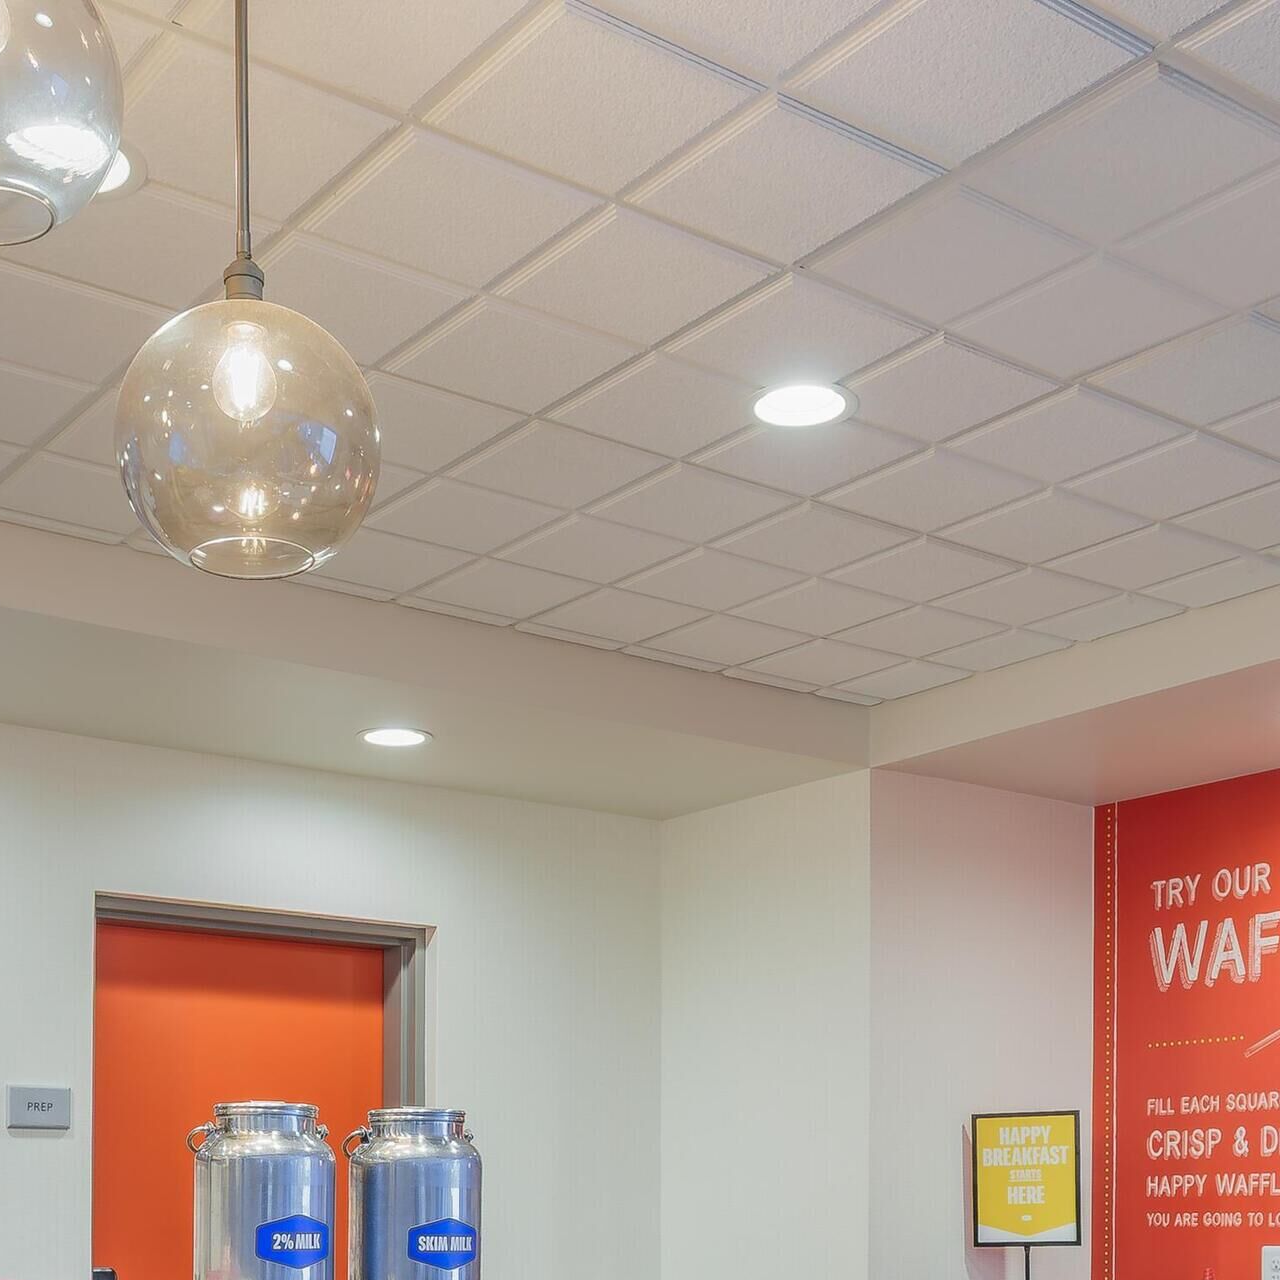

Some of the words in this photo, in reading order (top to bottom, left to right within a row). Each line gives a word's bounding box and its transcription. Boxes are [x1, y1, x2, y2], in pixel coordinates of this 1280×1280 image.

[1151, 873, 1201, 910] TRY
[1212, 862, 1271, 901] OUR
[27, 1101, 54, 1113] PREP
[1147, 1097, 1175, 1116] FILL
[1180, 1094, 1220, 1115] EACH
[999, 1125, 1052, 1145] HAPPY
[1146, 1127, 1222, 1160] CRISP
[1232, 1126, 1250, 1158] &
[982, 1145, 1069, 1167] BREAKFAST
[1008, 1169, 1042, 1180] STARTS
[1007, 1186, 1046, 1205] HERE
[1146, 1174, 1208, 1198] HAPPY
[1146, 1212, 1171, 1228] YOU
[1174, 1211, 1199, 1228] ARE
[1202, 1211, 1242, 1228] GOING
[1247, 1211, 1264, 1228] TO
[272, 1233, 293, 1250] 2%
[295, 1233, 321, 1250] MILK
[417, 1235, 448, 1252] SKIM
[450, 1235, 473, 1252] MILK
